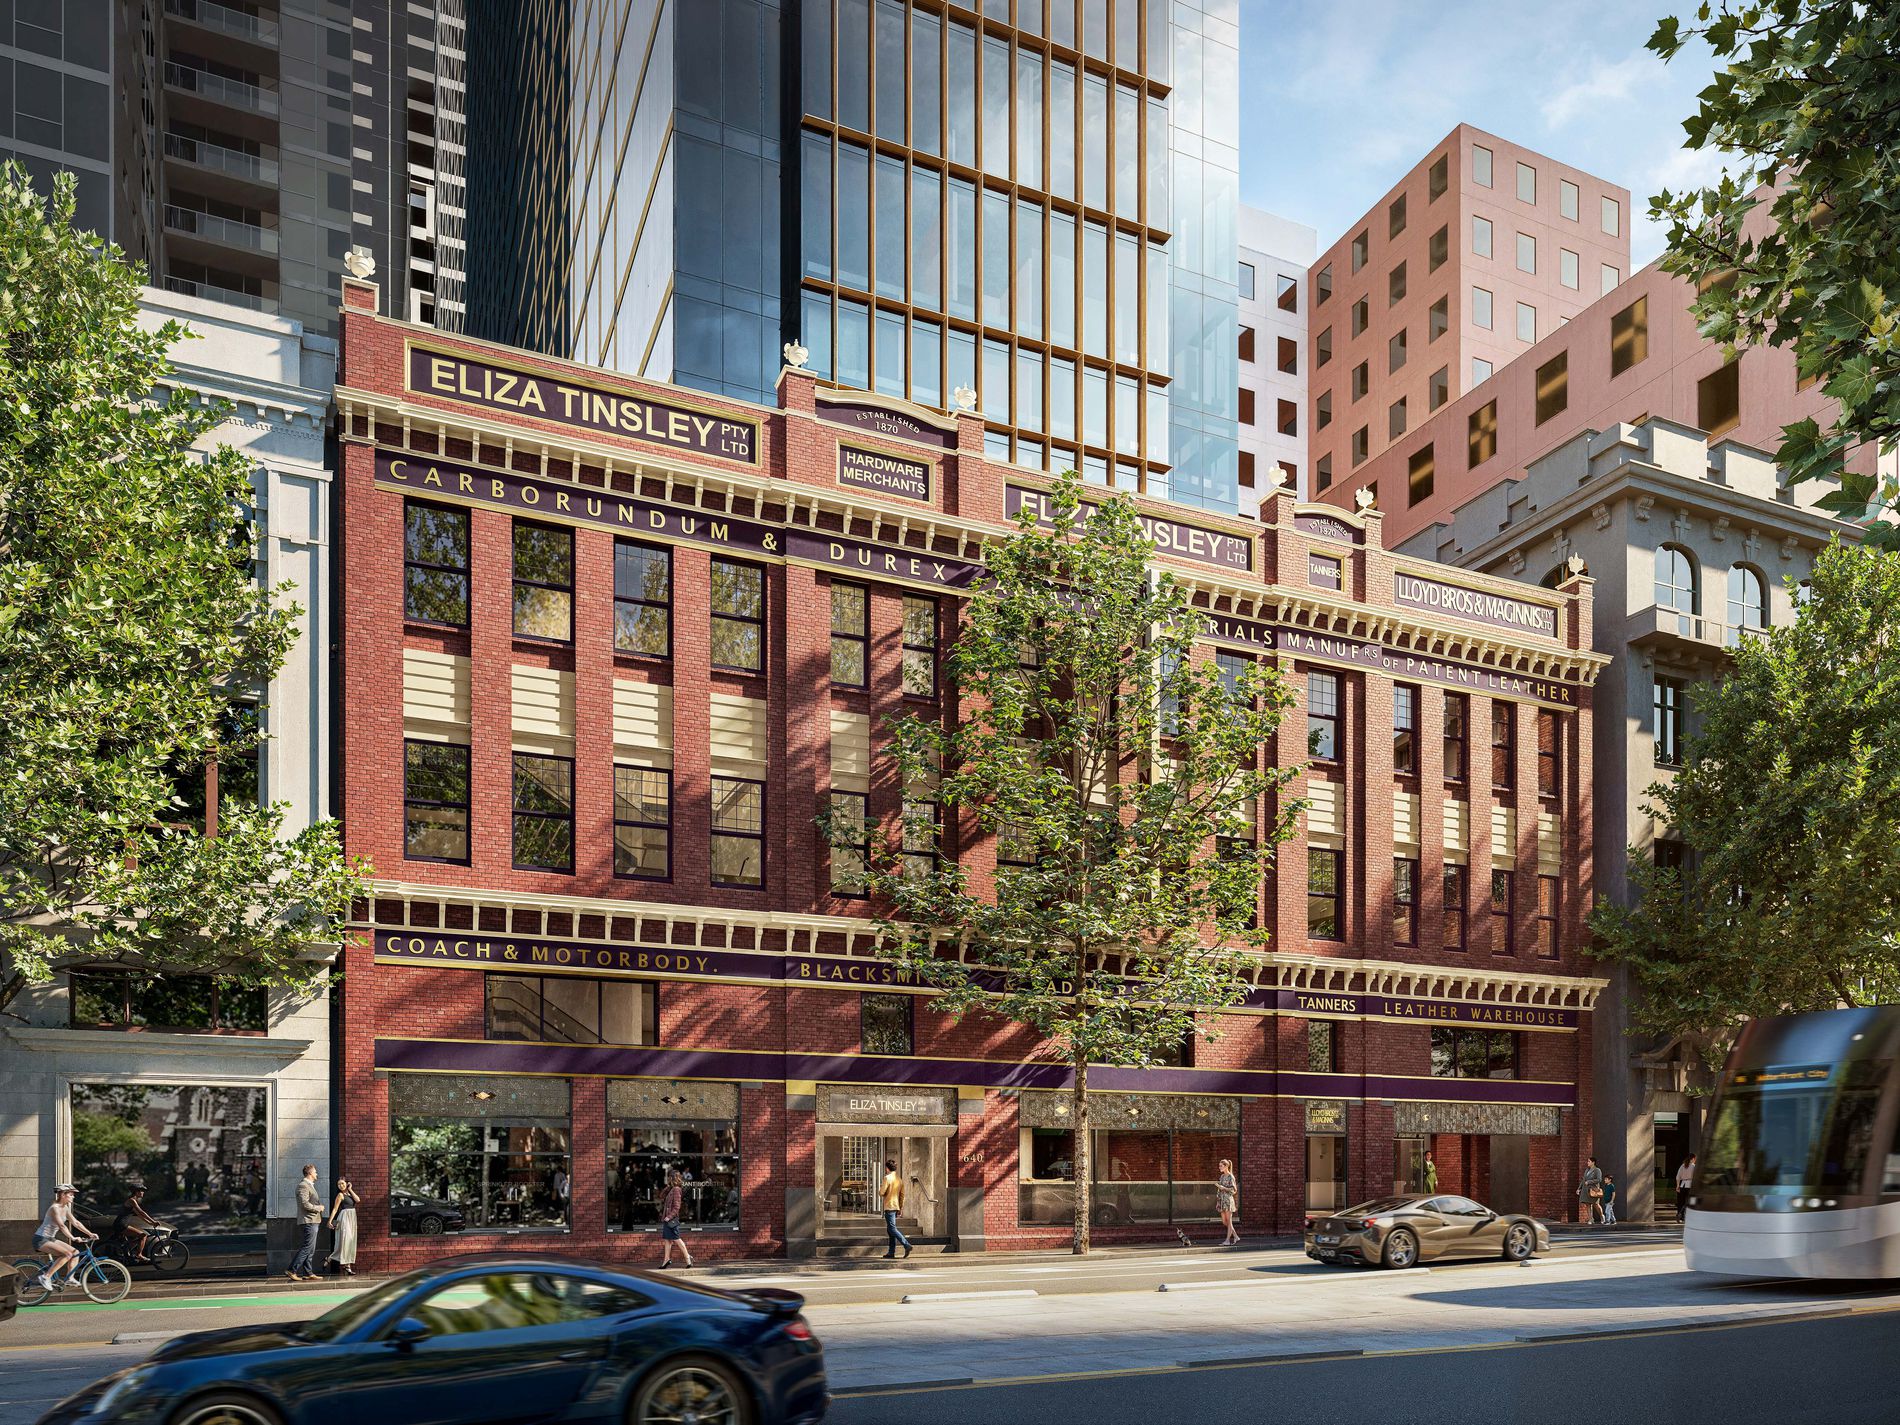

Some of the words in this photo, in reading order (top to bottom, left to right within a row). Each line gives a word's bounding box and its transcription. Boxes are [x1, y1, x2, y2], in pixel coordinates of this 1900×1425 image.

[431, 357, 546, 412] ELIZA
[557, 386, 716, 447] TINSLEY
[856, 411, 920, 434] ESTABLISHED
[875, 421, 899, 434] 1870
[721, 423, 749, 440] PTY
[721, 439, 749, 456] LTD
[846, 451, 923, 479] HARDWARE
[843, 466, 926, 495] MERCHANTS
[390, 460, 728, 542] CARBORUNDUM
[762, 532, 777, 551] &
[830, 542, 946, 581] DUREX
[1020, 491, 1097, 530] ELZA
[1114, 516, 1224, 558] NSLEY
[1226, 537, 1247, 551] PTY
[1226, 551, 1247, 564] LTD
[1310, 563, 1341, 579] TANNERS
[1398, 576, 1440, 606] LLOYD
[1440, 586, 1473, 614] BROS
[1474, 594, 1484, 617] &
[1485, 597, 1541, 629] MAGINNIS
[1383, 657, 1399, 669] OF
[1406, 657, 1481, 686] PATENT
[1488, 673, 1570, 702] LEATHER
[386, 936, 491, 959] COACH
[503, 944, 519, 961] &
[531, 945, 718, 973] MOTORBODY.
[800, 962, 968, 987] BLACKSMIS
[1298, 996, 1356, 1012] TANNERS
[1384, 1002, 1458, 1019] LEATHER
[1470, 1007, 1565, 1026] WAREHOUSE
[850, 1099, 877, 1111] ELIZA
[878, 1099, 917, 1112] TINSLEY
[962, 1154, 984, 1164] 640
